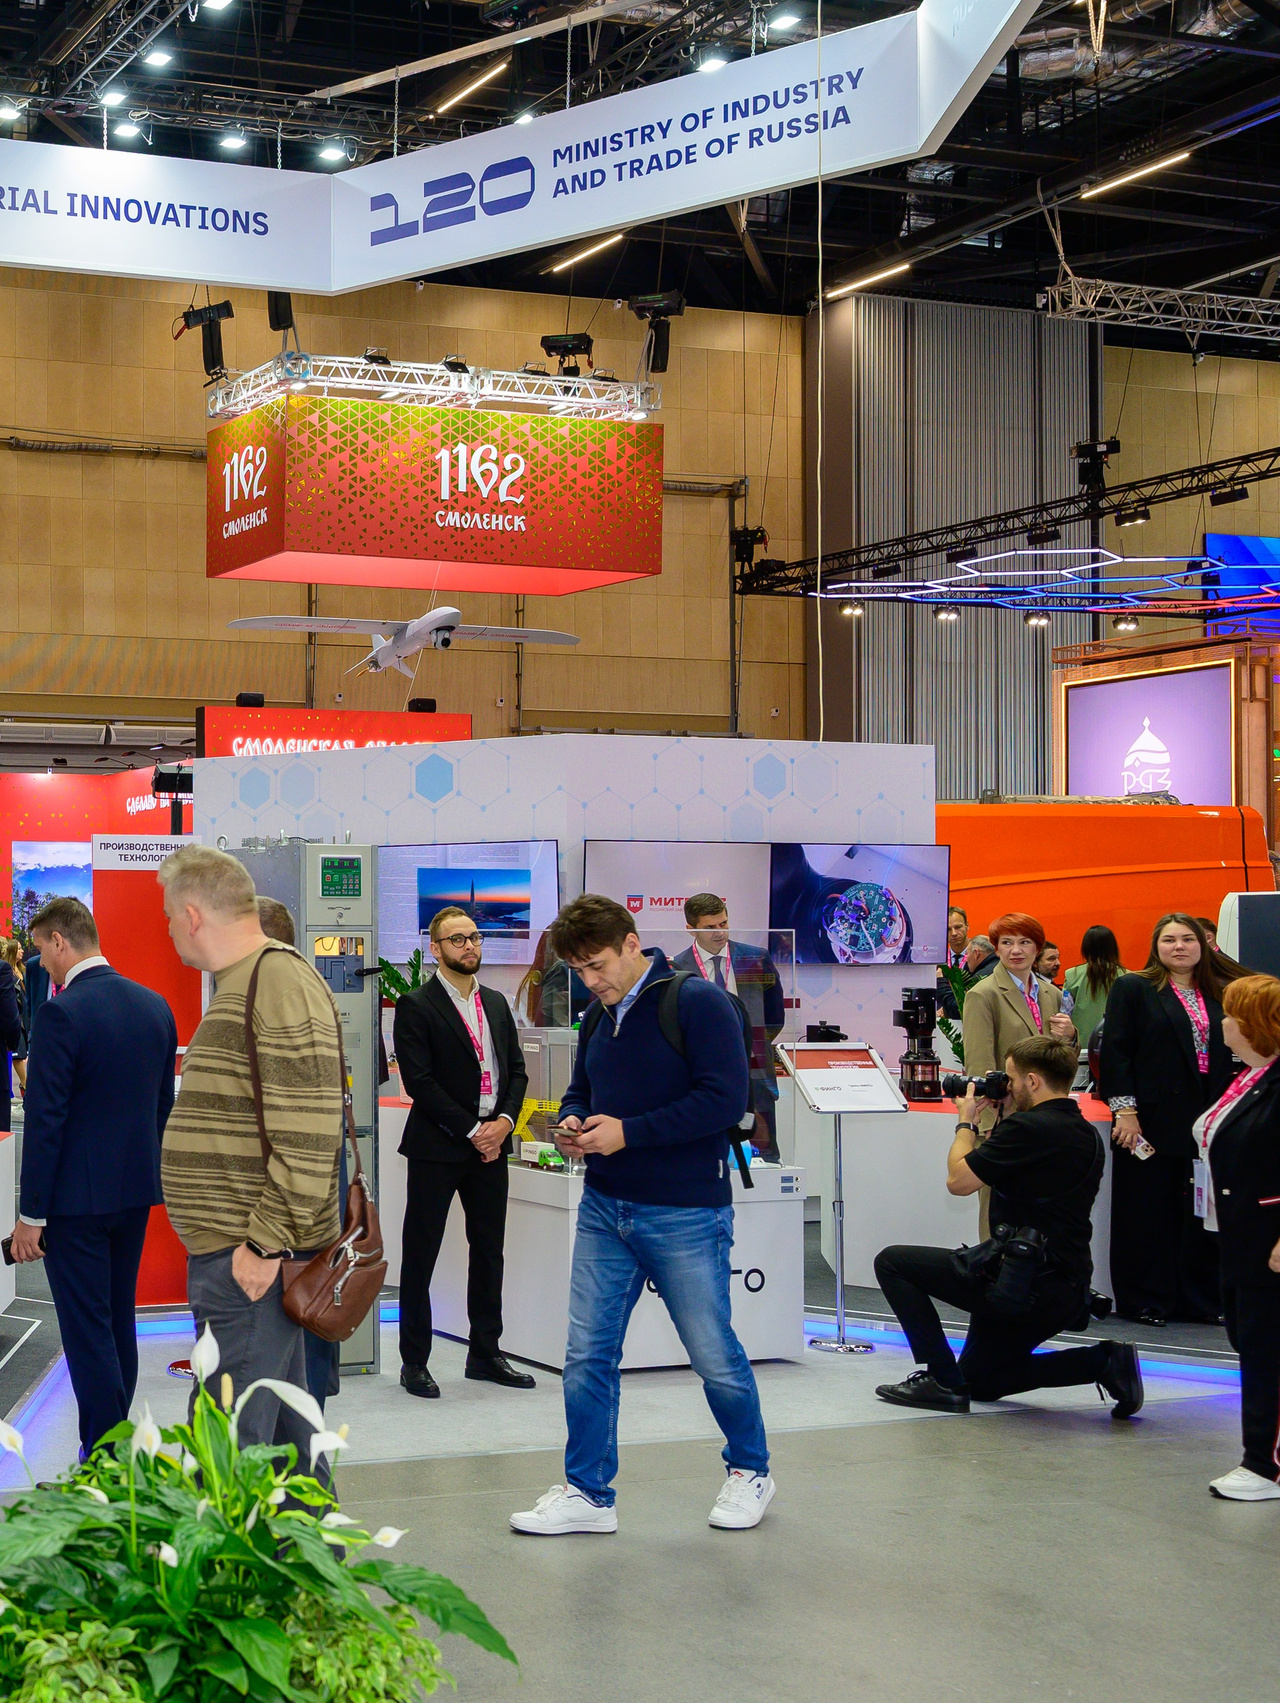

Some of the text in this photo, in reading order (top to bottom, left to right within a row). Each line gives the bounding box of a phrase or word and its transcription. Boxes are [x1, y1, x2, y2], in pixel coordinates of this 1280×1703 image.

[552, 67, 865, 168] MINISTRY OF INDUSTRY
[552, 105, 852, 199] AND TRADE OF RUSSIA
[66, 192, 269, 236] INNOVATIONS
[370, 156, 535, 247] 120
[223, 445, 268, 513] 1162
[435, 442, 526, 505] 1162
[223, 506, 268, 541] СМОЛЕНСК
[435, 510, 526, 533] СМОЛЕНСК
[99, 842, 185, 852] ПРОИЗВОДСТВЕНН
[118, 854, 167, 862] ТЕХНОЛОГ
